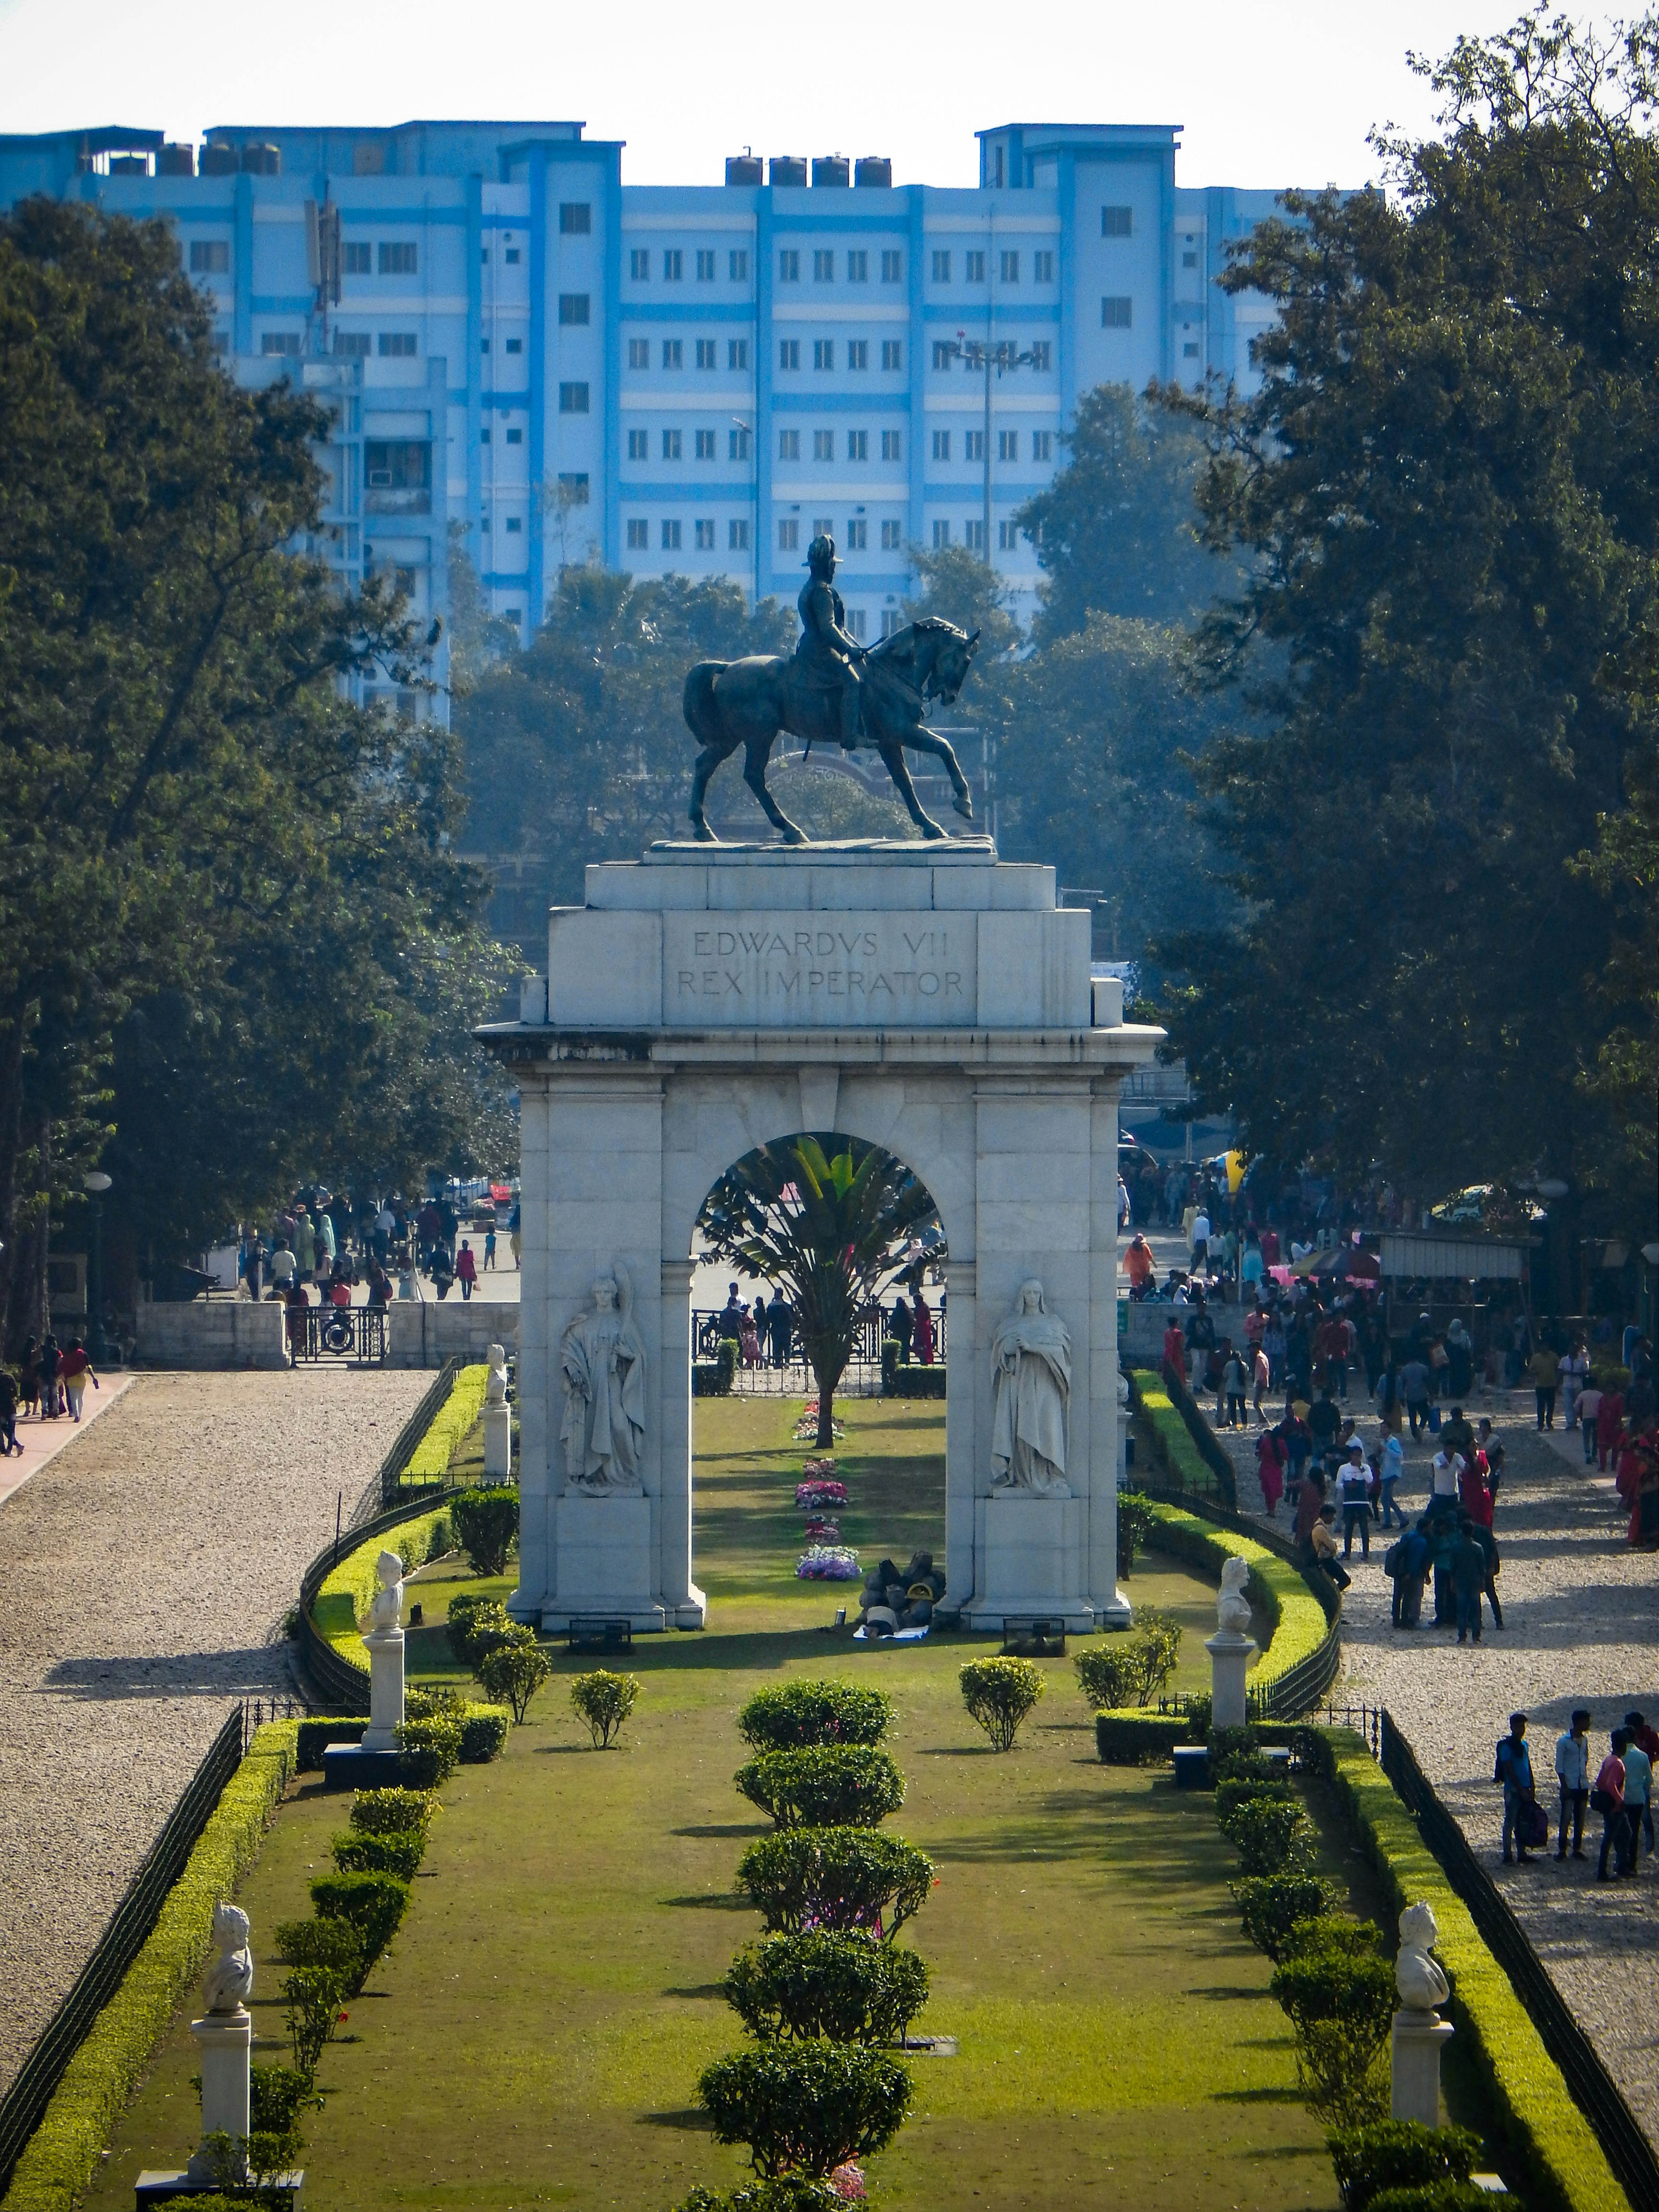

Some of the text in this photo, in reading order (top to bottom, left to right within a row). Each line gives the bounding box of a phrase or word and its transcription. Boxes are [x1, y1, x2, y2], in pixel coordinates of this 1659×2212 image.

[694, 932, 947, 956] EDWARDVS VII
[678, 971, 962, 995] REX IMPERATOR
